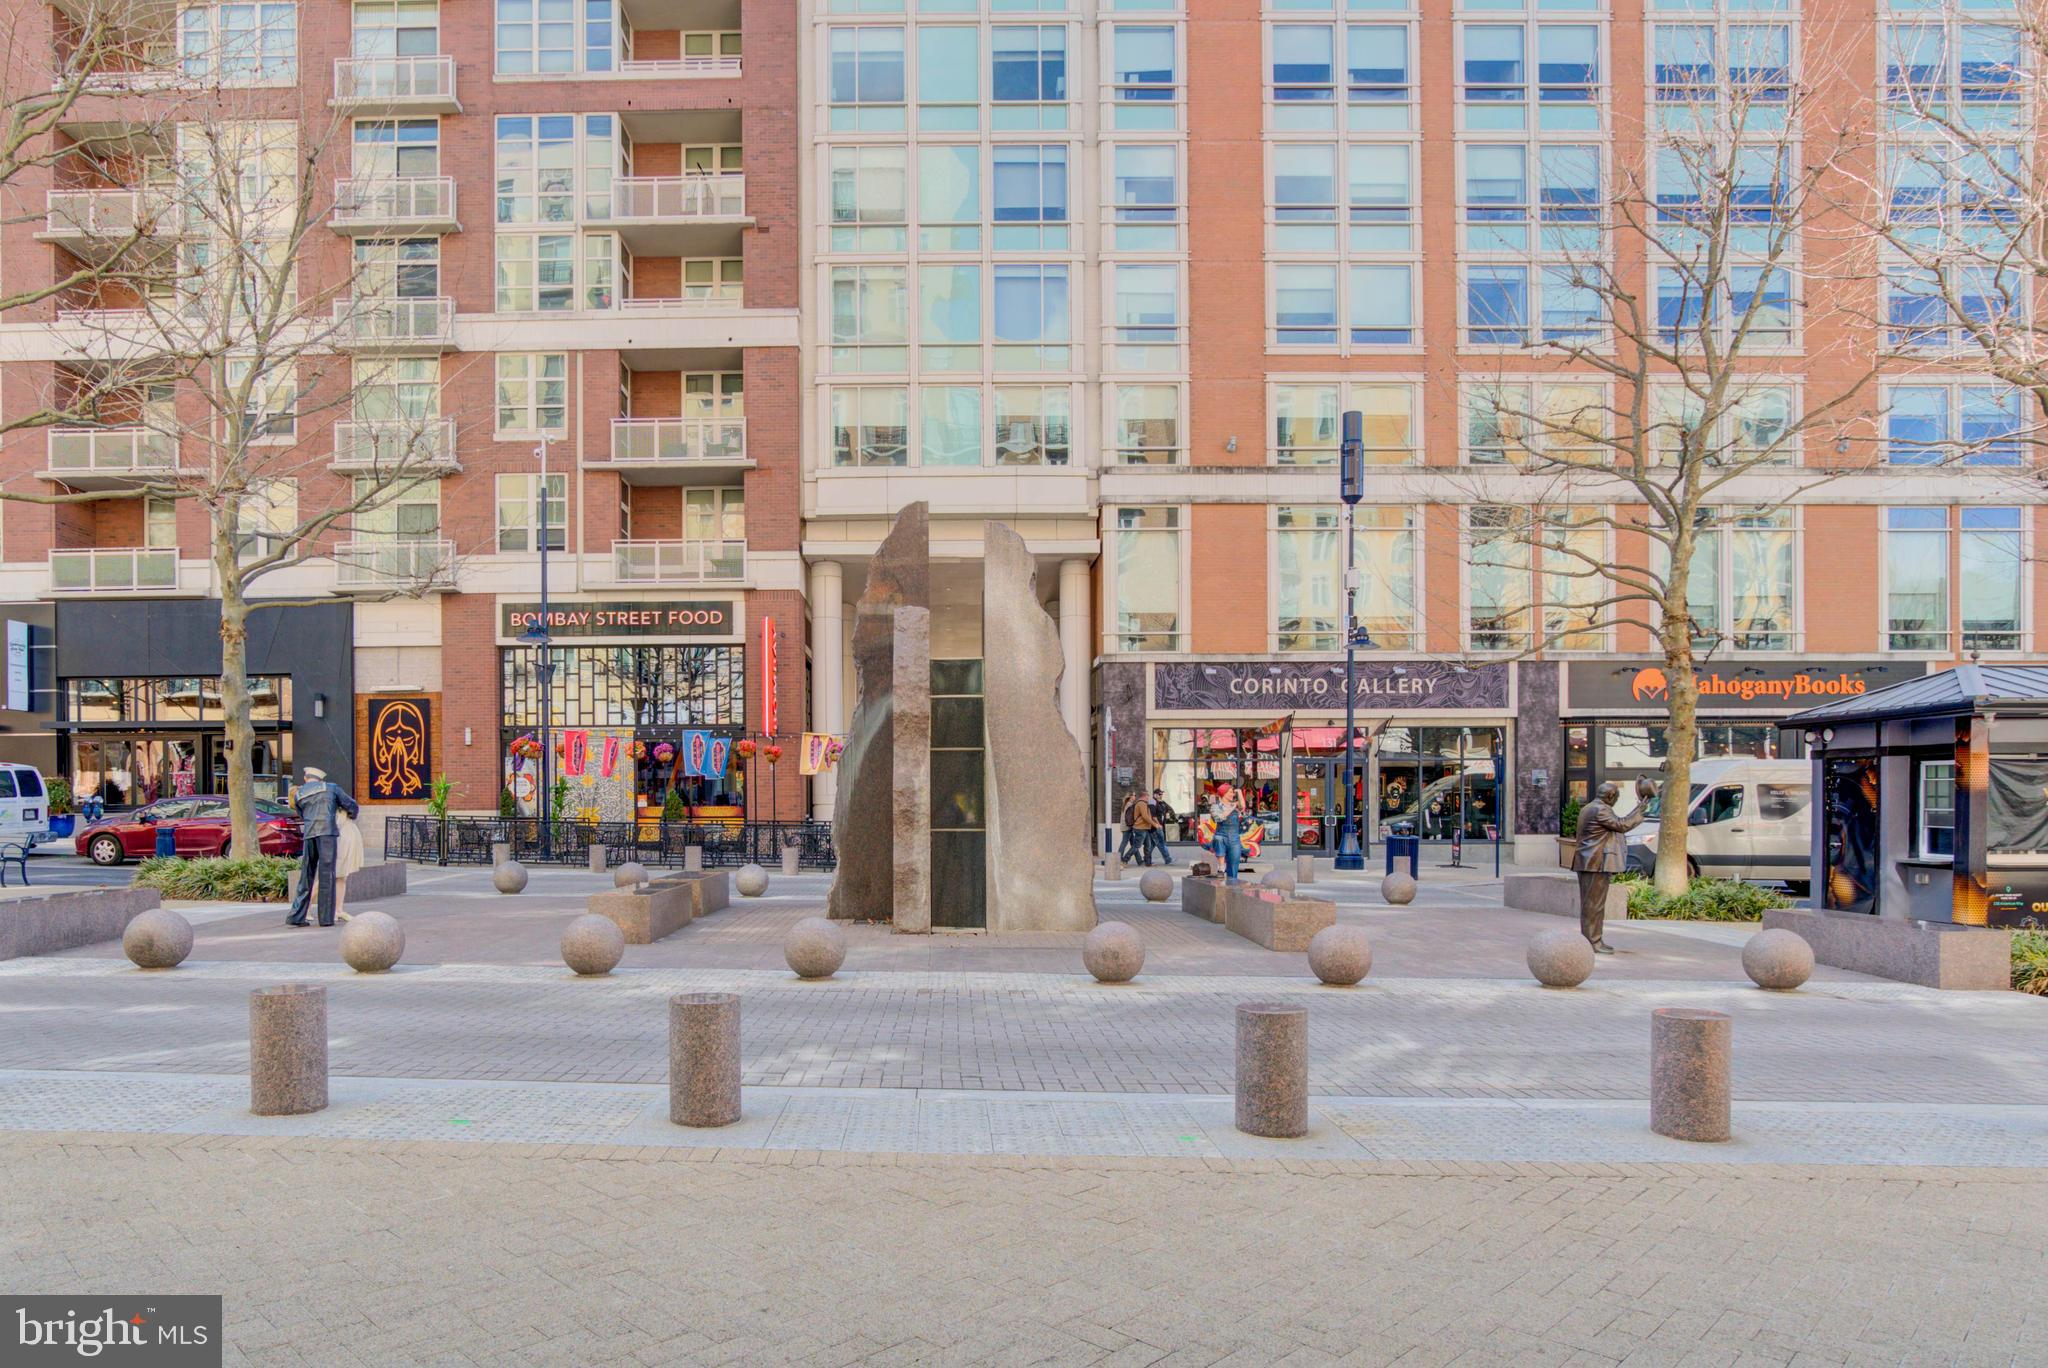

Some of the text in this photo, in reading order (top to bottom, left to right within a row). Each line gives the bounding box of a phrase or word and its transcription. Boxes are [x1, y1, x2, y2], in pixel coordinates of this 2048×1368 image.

[511, 610, 723, 627] BOMBAY STREET FOOD
[1230, 677, 1328, 695] CORINTO
[1691, 674, 1866, 700] ahoganyBooks
